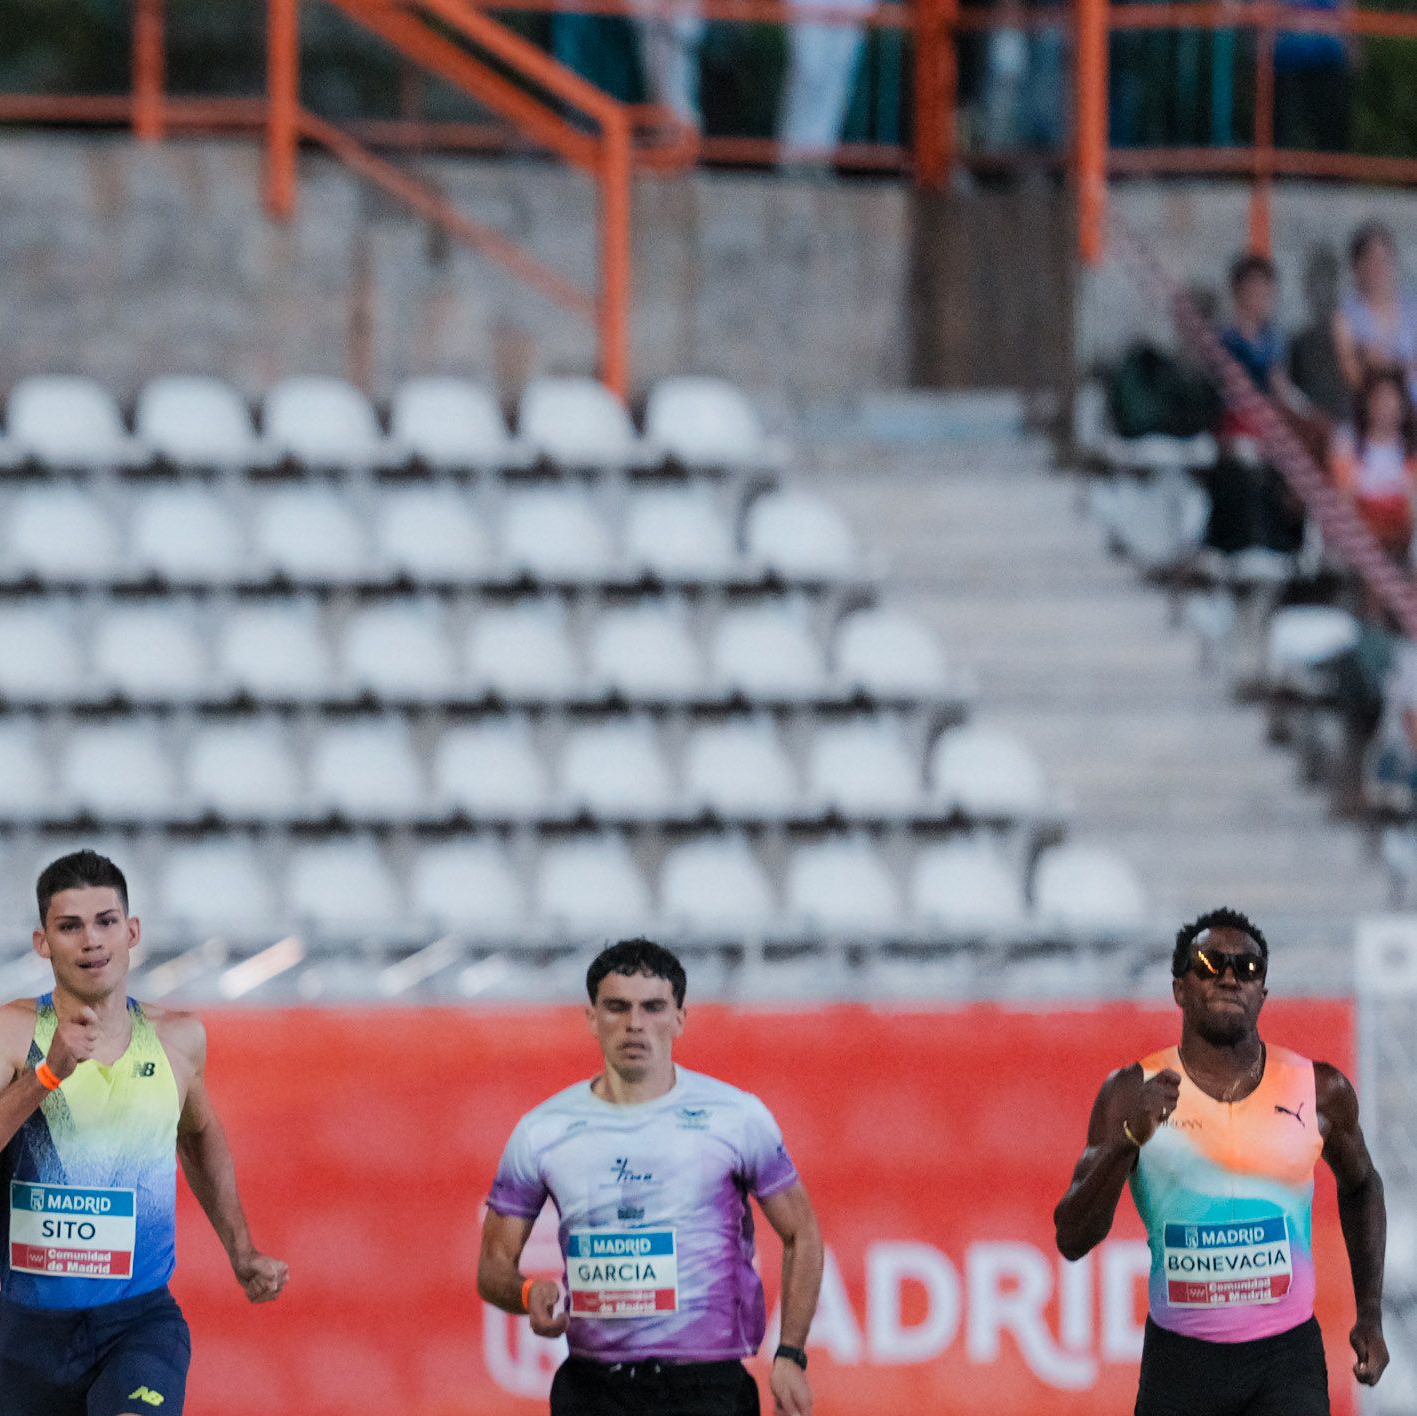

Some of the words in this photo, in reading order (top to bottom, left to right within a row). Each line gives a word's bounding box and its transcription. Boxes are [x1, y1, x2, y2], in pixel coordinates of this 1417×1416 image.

[47, 1194, 112, 1215] MADRID
[42, 1220, 96, 1240] SITO
[1201, 1226, 1265, 1246] MADRID
[47, 1248, 112, 1262] Comunidad
[593, 1238, 652, 1257] MADRID
[47, 1261, 64, 1272] de
[67, 1262, 111, 1275] Madrid
[1168, 1249, 1286, 1272] BONEVACIA
[577, 1263, 657, 1281] GARCIA
